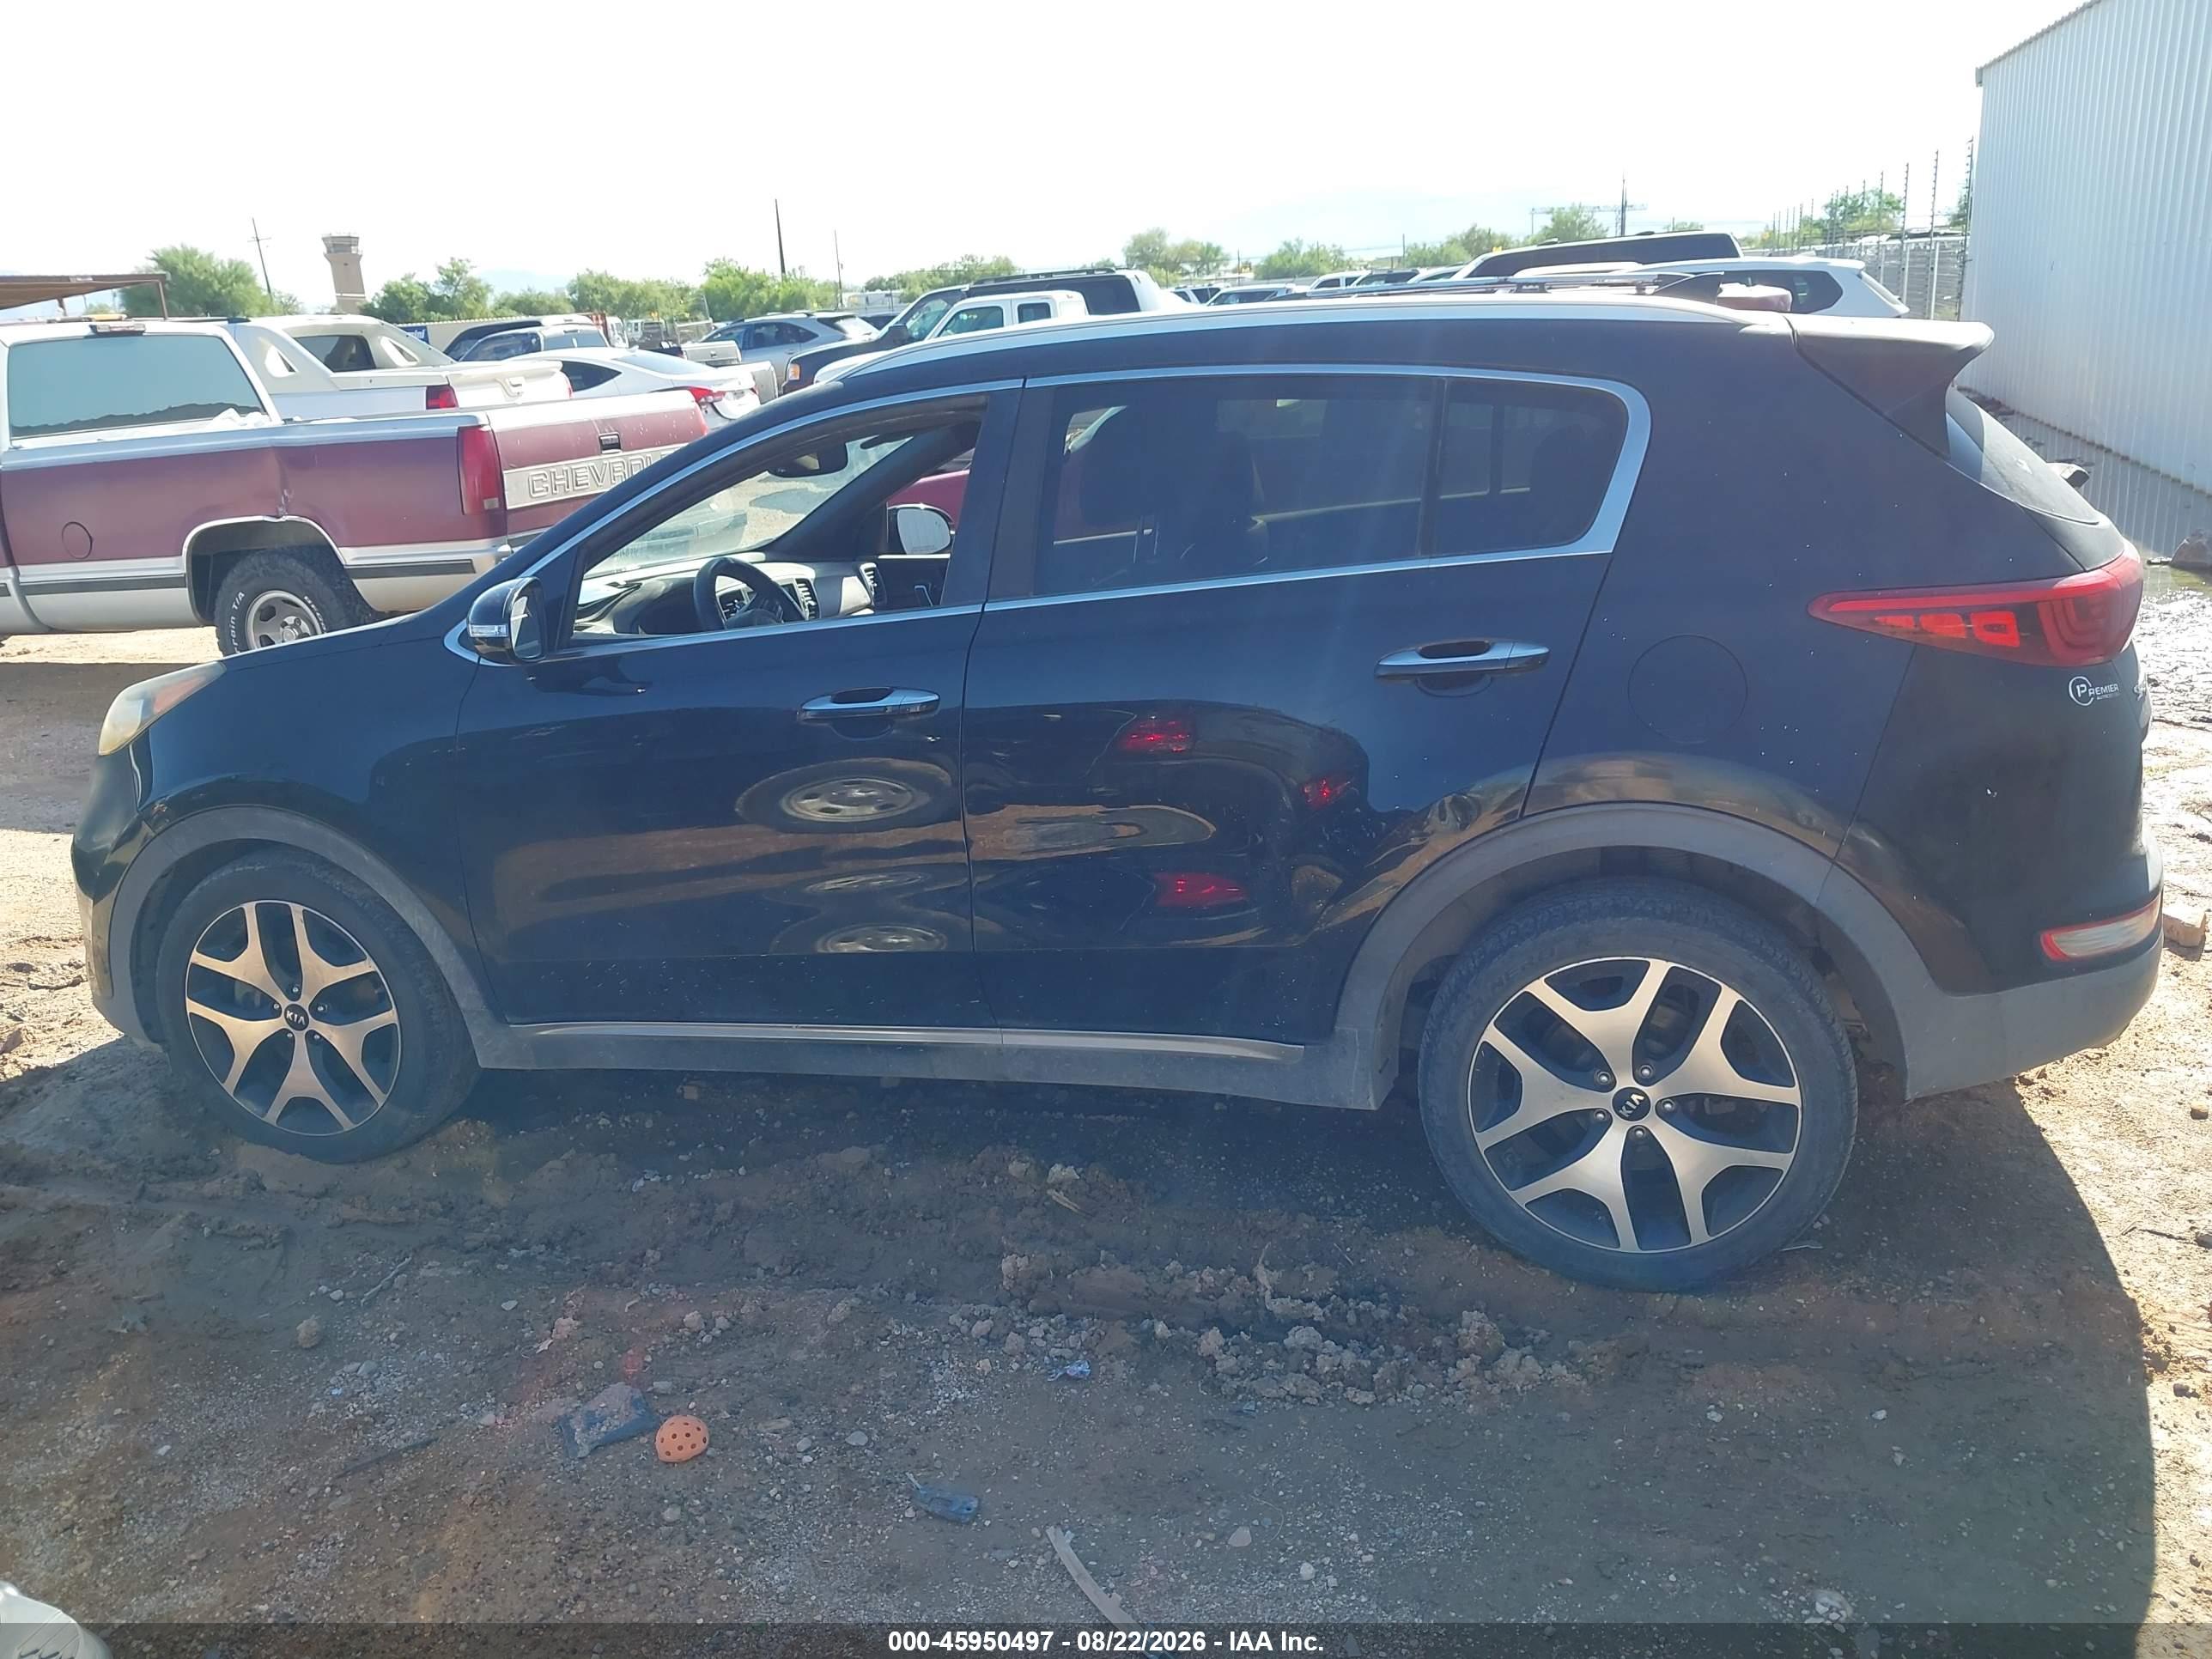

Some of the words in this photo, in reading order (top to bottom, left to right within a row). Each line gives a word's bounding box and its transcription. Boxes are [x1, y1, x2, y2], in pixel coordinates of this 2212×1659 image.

[2075, 683, 2119, 698] PREMIER
[286, 1010, 306, 1025] KIA
[1619, 1093, 1645, 1117] KIA
